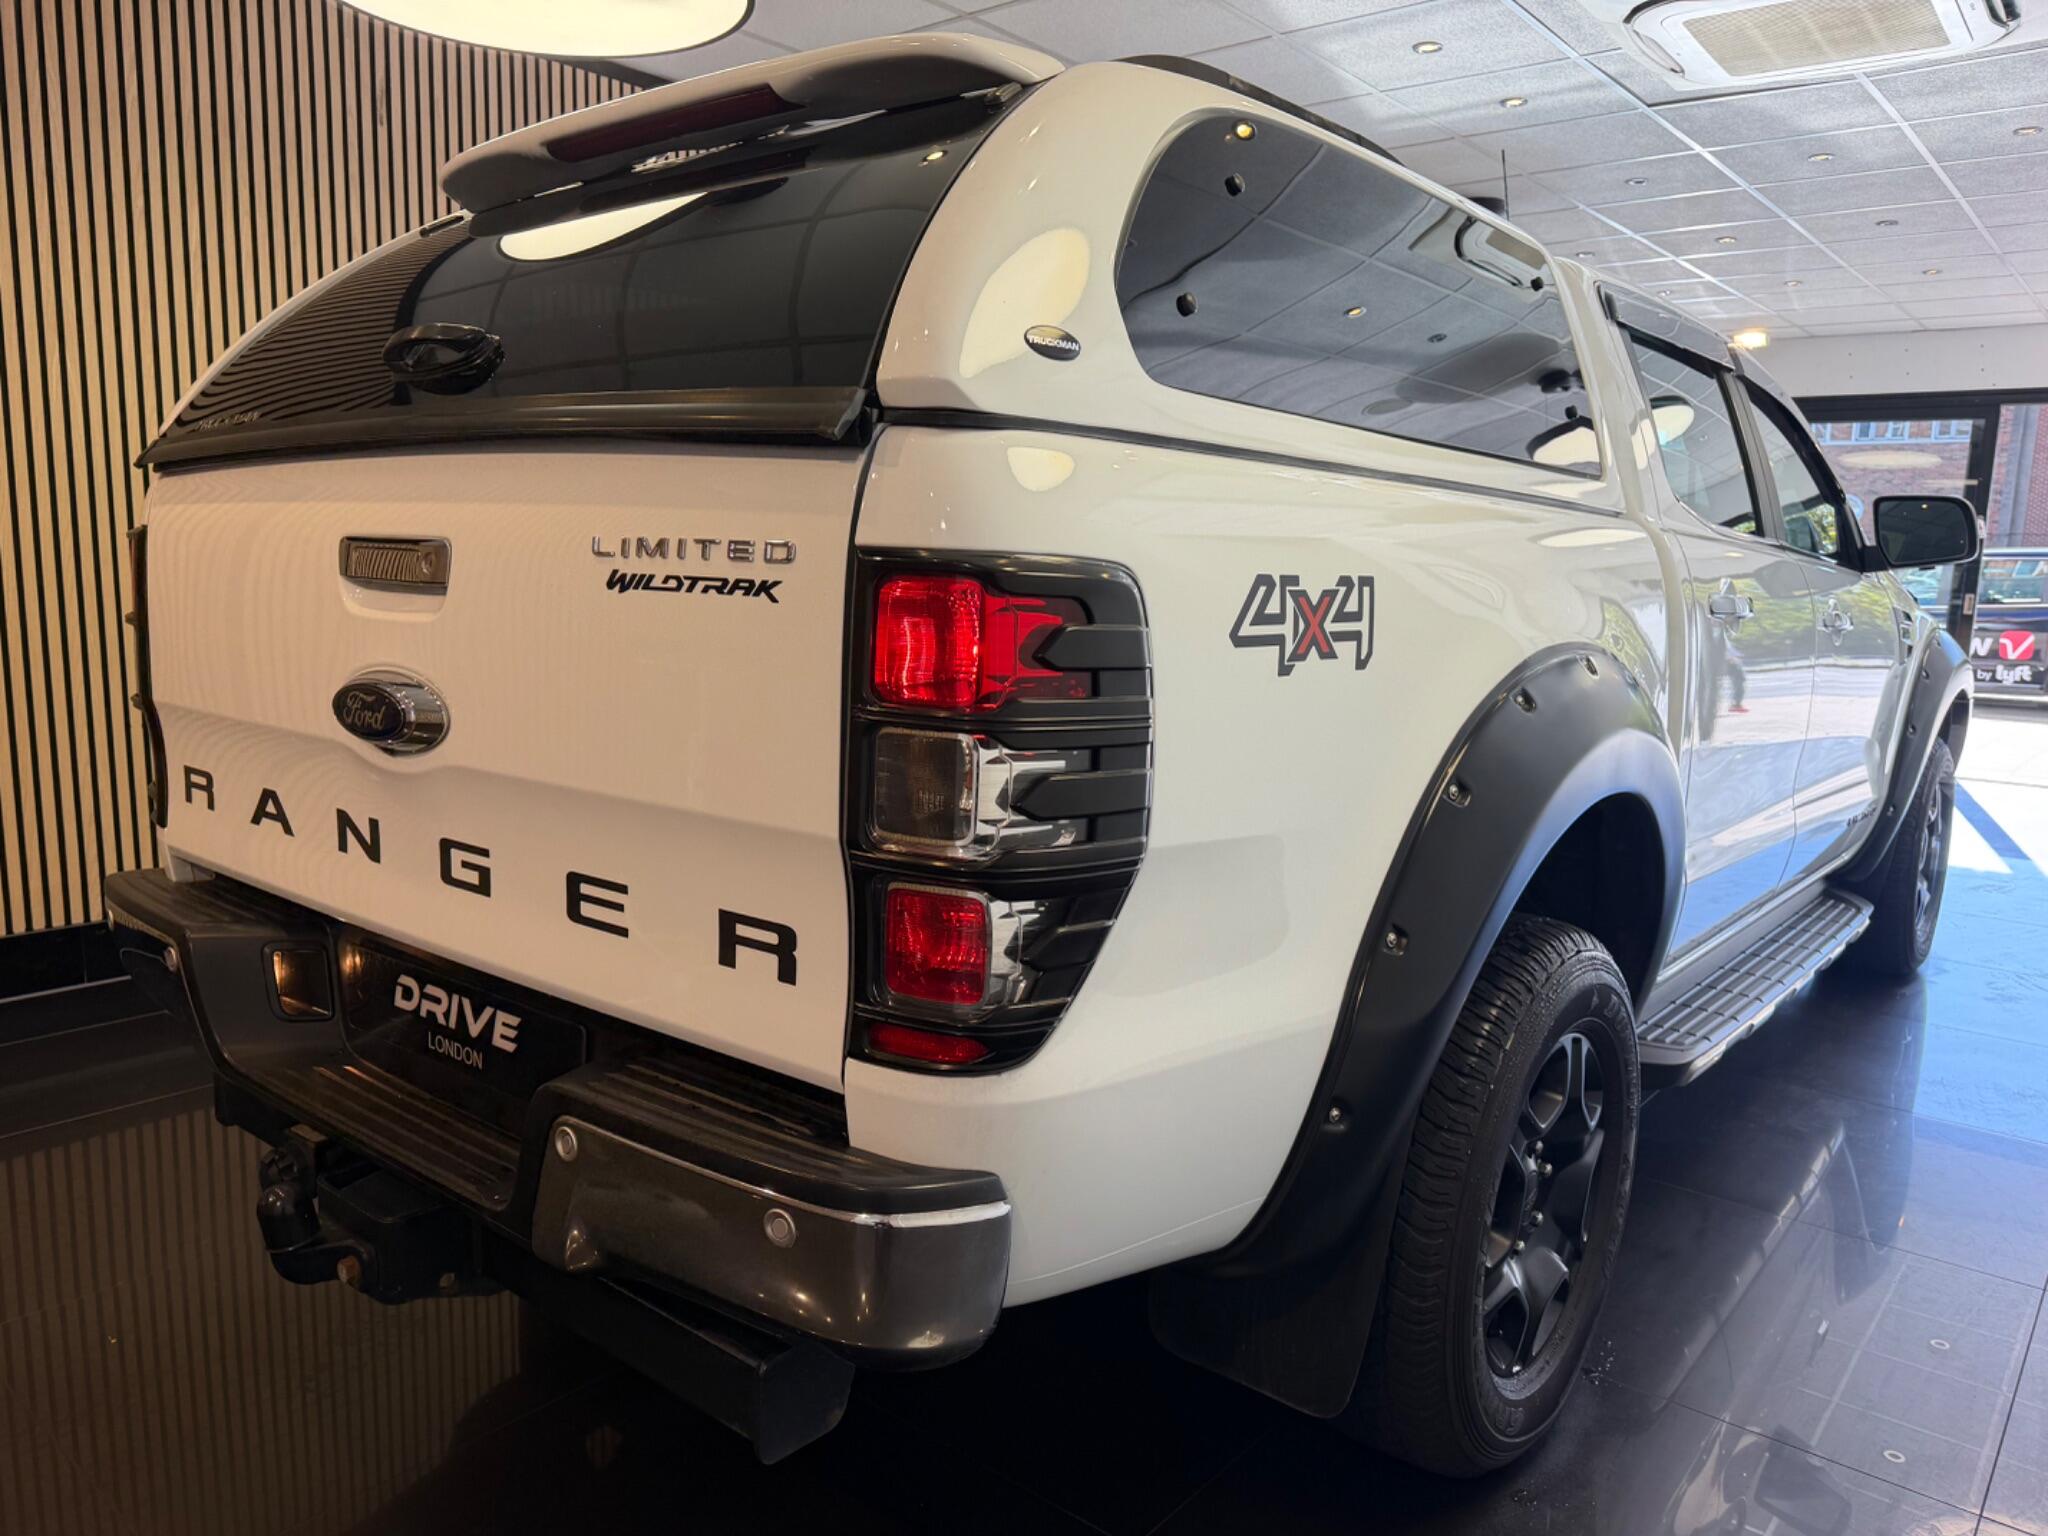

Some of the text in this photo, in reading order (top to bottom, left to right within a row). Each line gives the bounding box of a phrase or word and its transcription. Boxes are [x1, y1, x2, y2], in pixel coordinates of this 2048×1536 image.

[591, 535, 797, 565] LIMITED
[605, 568, 783, 604] WILDTRAK
[1976, 669, 1993, 682] by
[343, 691, 387, 731] Ford
[183, 764, 797, 986] RANGER
[393, 974, 522, 1053] DRIVE
[428, 1031, 483, 1070] LONDON
